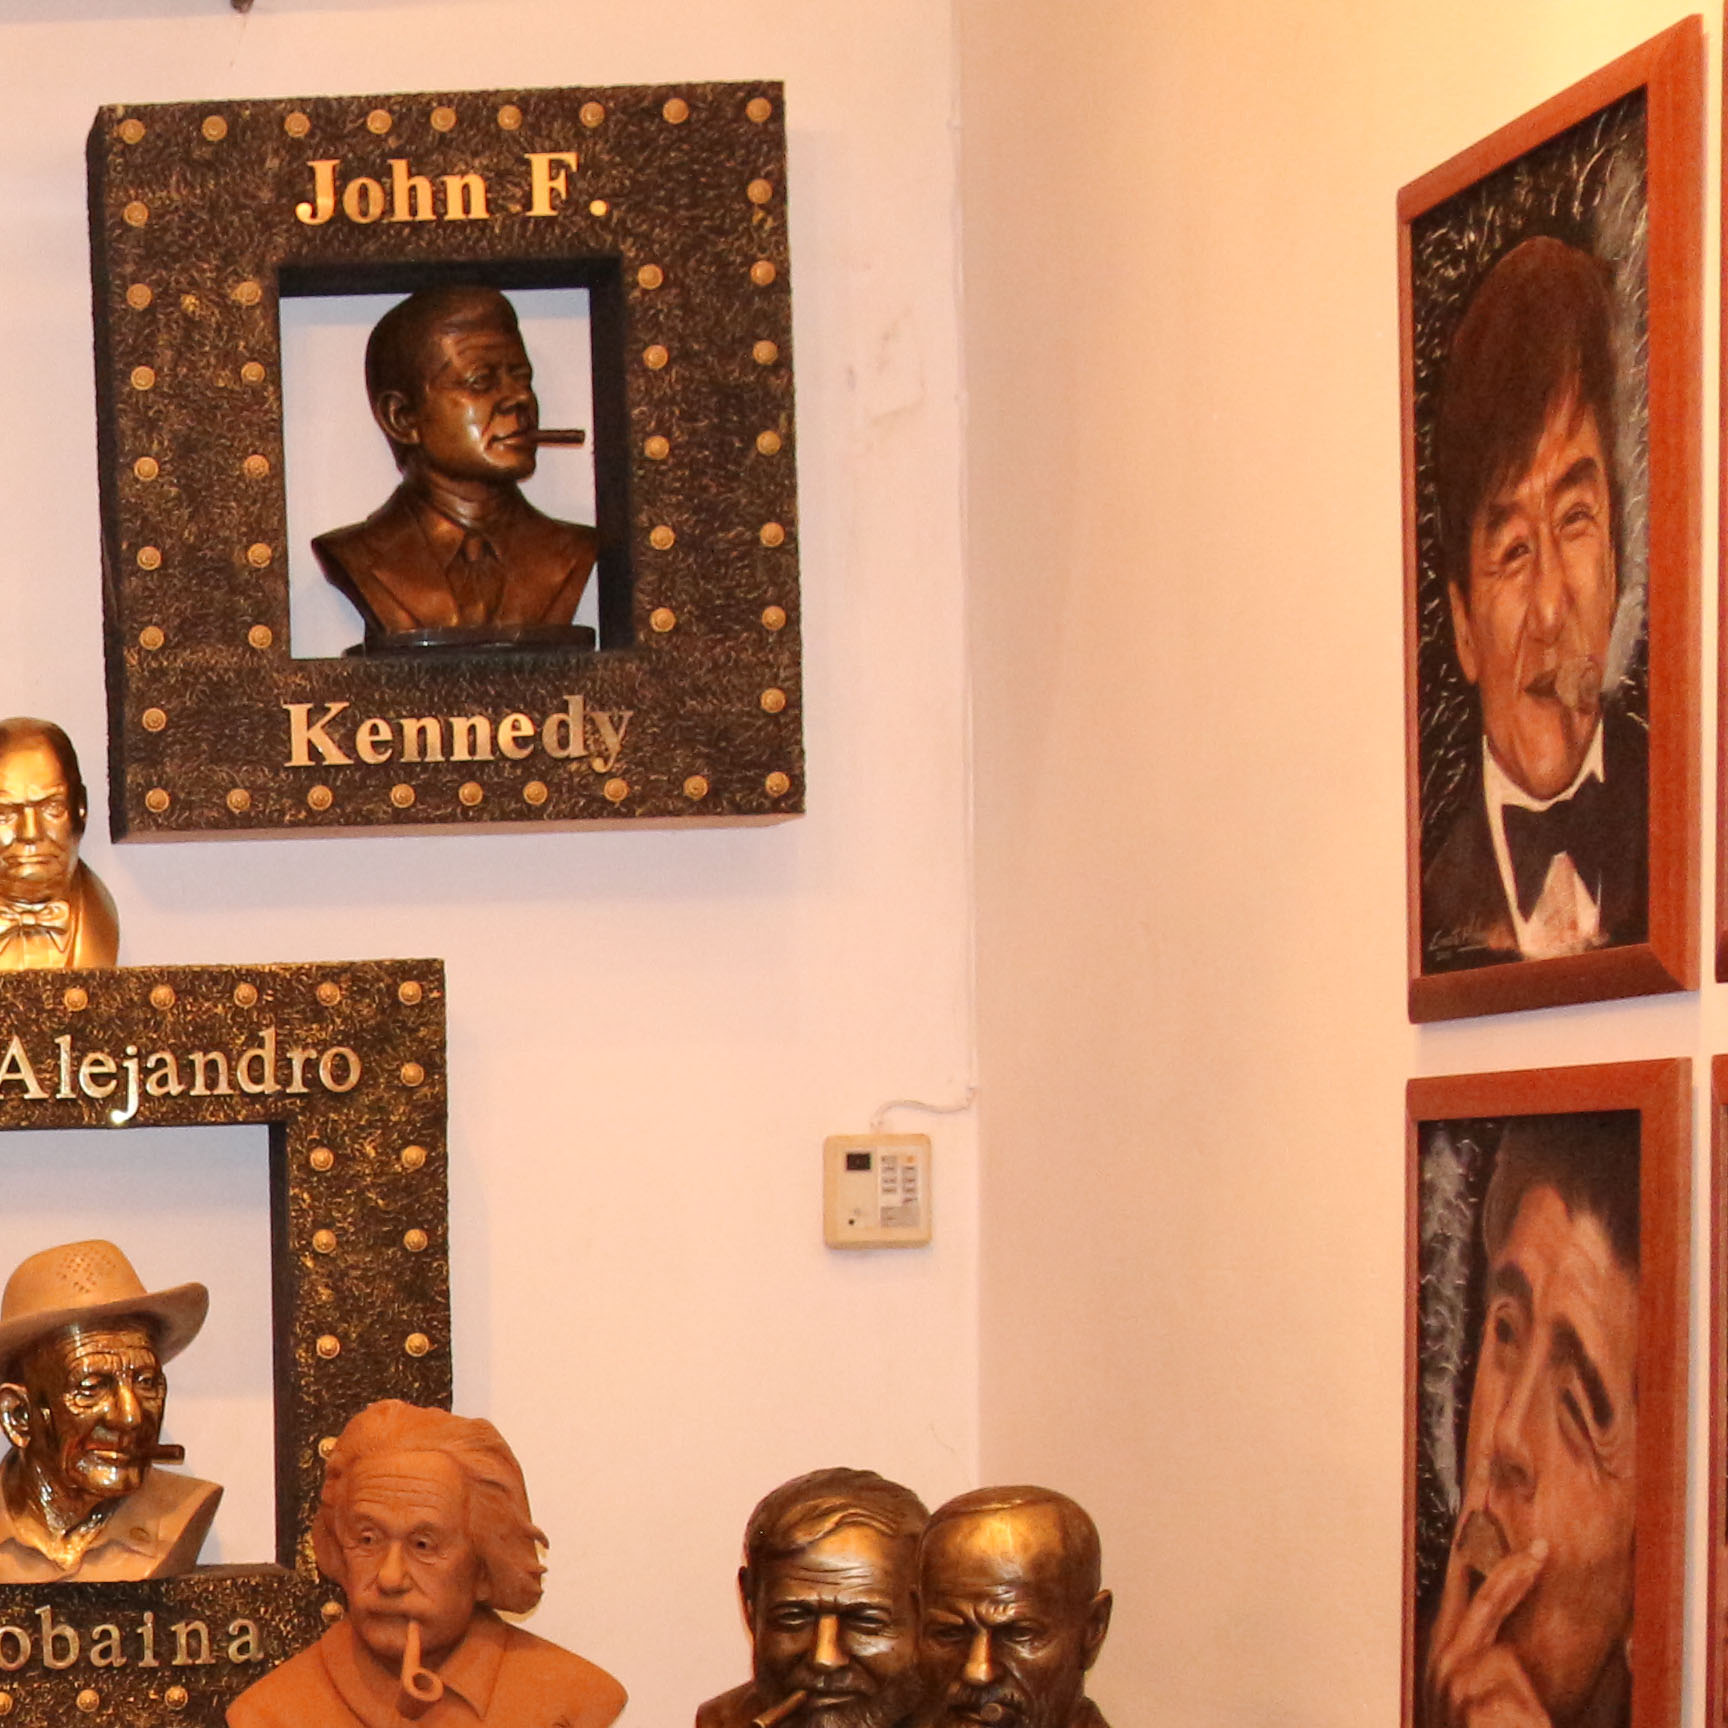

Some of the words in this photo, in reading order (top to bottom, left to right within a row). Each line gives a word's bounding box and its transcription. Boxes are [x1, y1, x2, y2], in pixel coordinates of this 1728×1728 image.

[295, 159, 490, 226] John
[524, 152, 609, 218] F.
[282, 695, 634, 774] Kennedy
